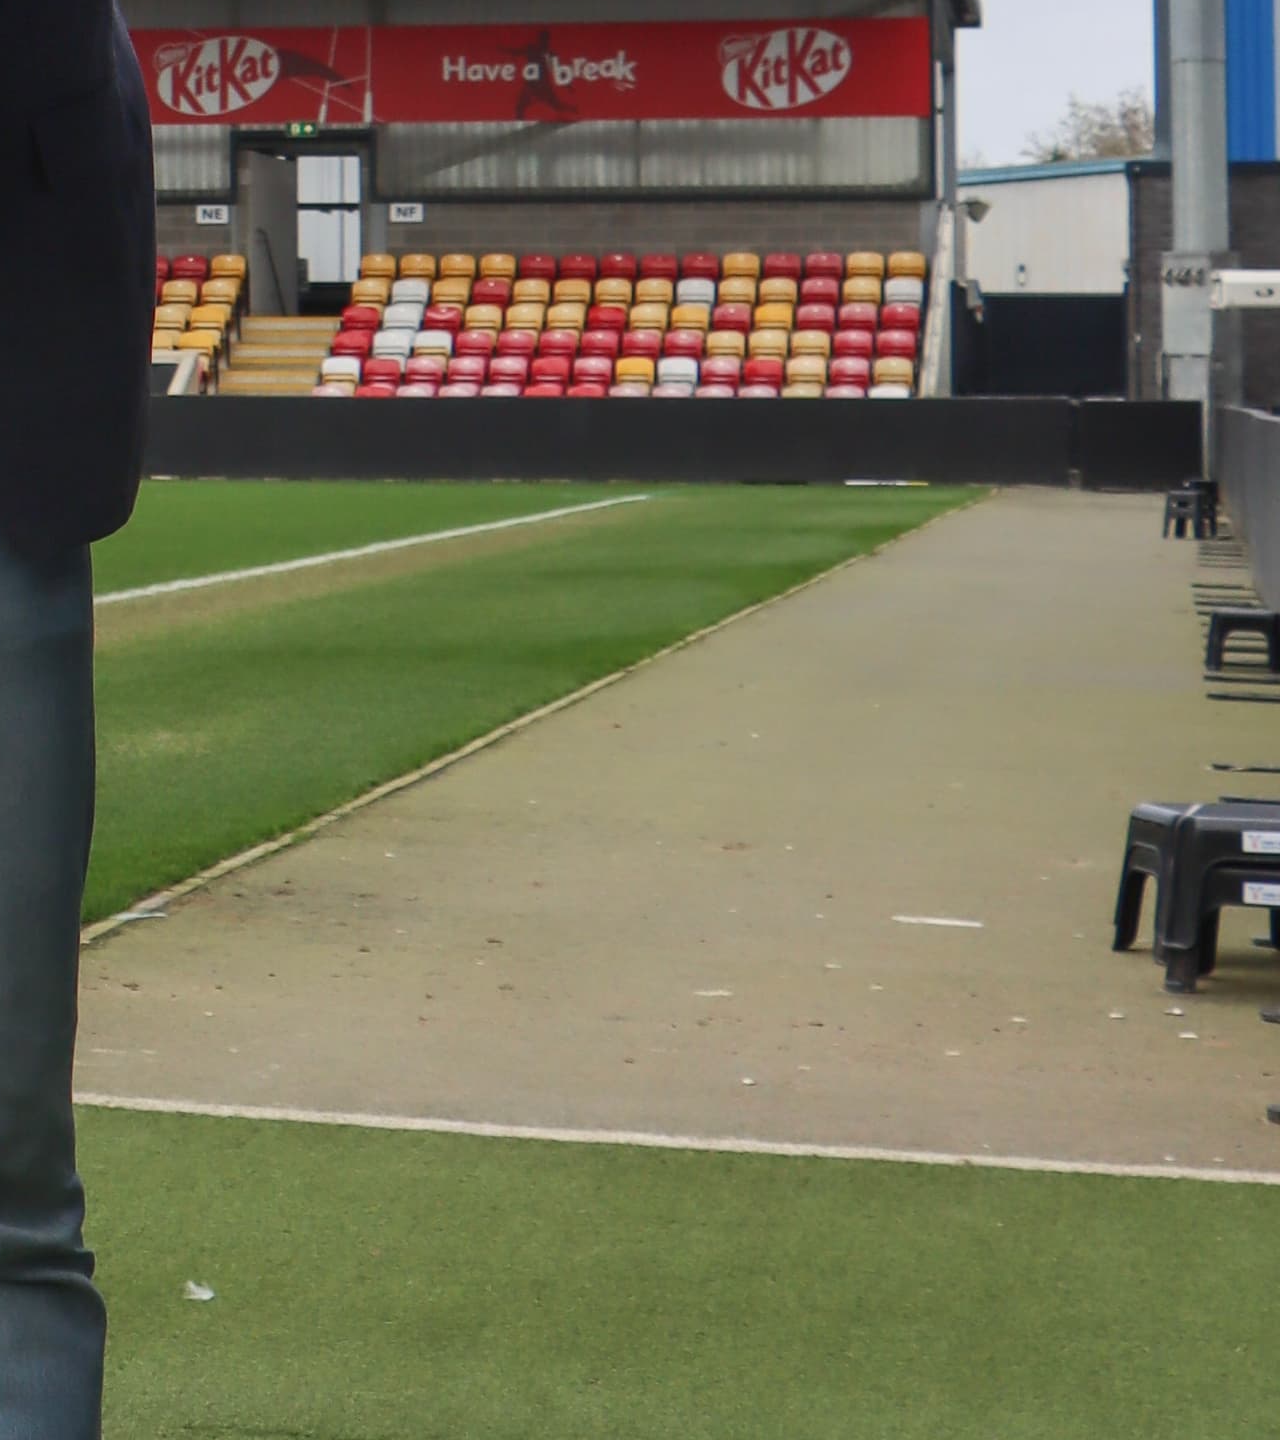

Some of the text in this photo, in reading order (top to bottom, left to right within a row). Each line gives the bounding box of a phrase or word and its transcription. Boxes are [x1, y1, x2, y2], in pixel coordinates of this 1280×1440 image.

[171, 39, 275, 114] KitKat
[442, 50, 637, 85] Have a break
[737, 29, 846, 108] KitKat
[201, 208, 223, 219] NE
